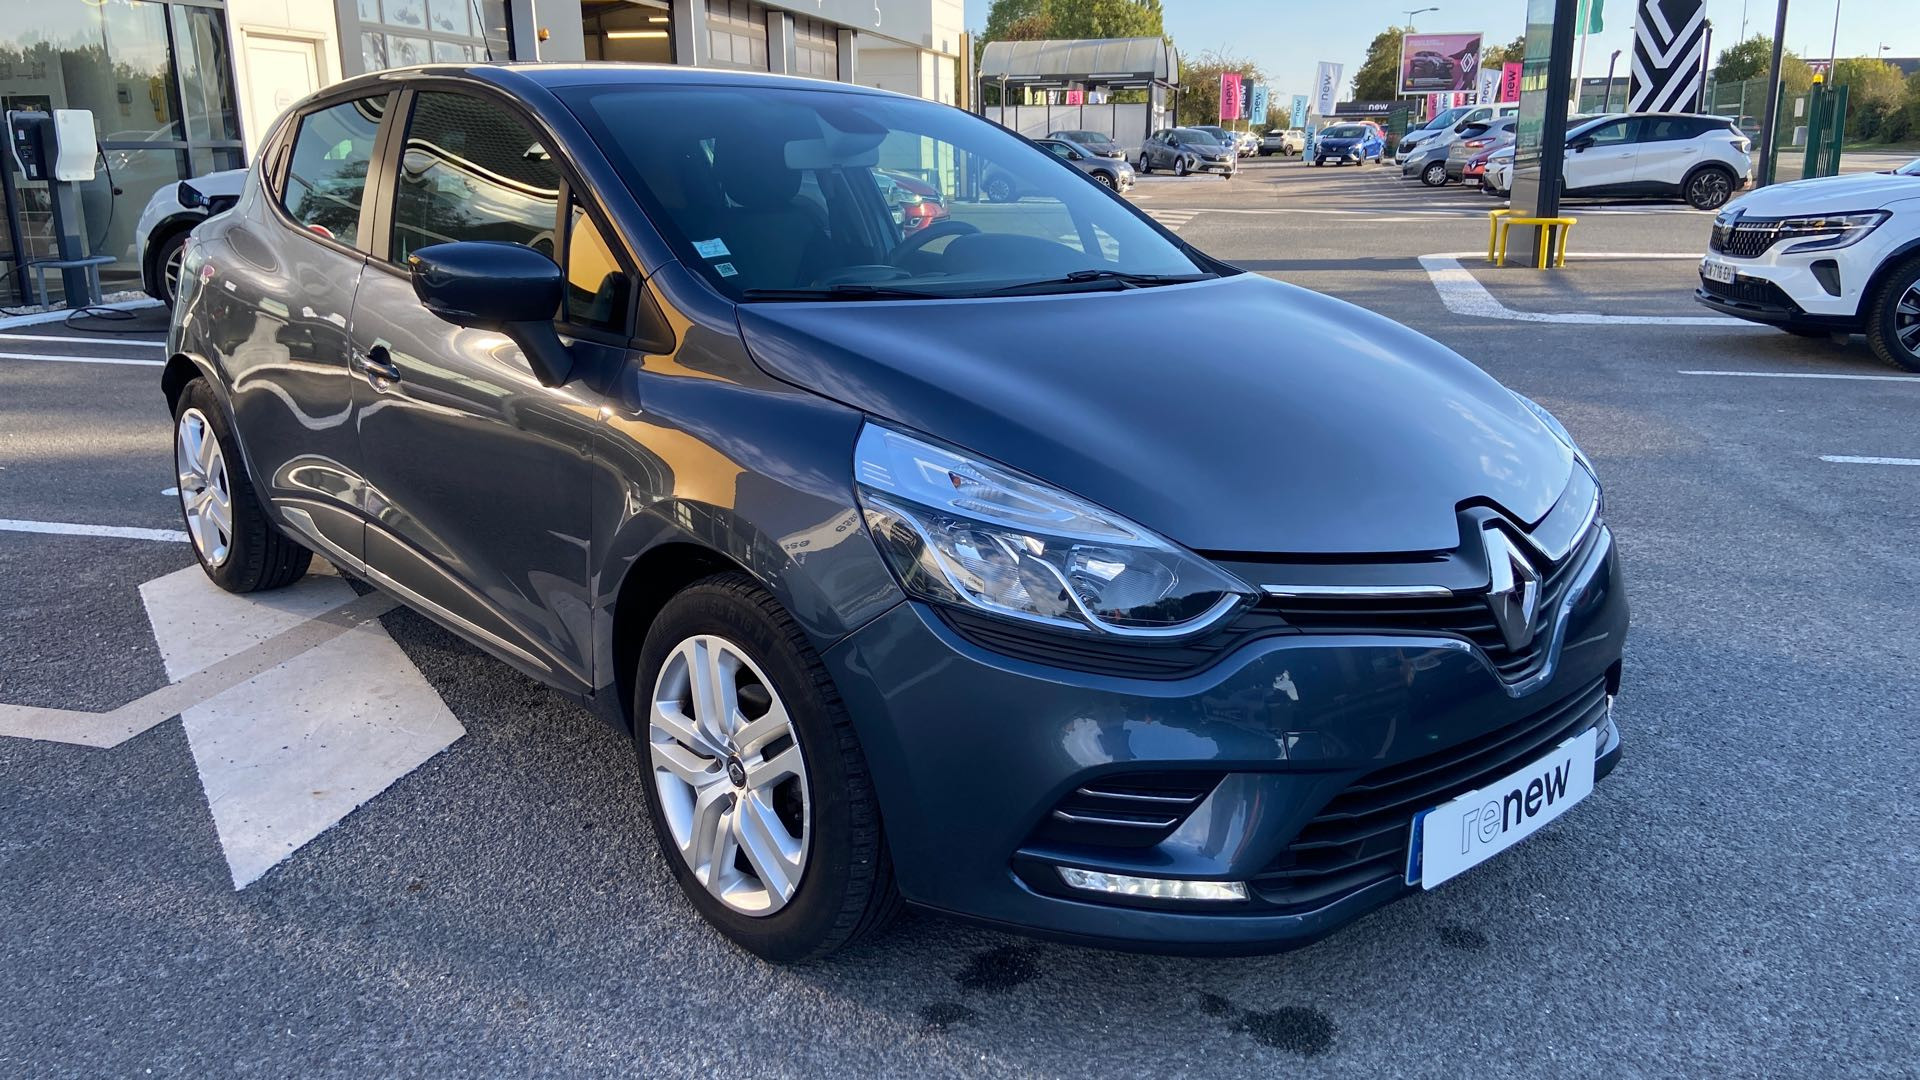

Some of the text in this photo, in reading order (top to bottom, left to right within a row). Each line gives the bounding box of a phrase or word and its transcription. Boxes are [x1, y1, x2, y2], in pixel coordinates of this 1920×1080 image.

[1226, 80, 1234, 105] new
[1322, 75, 1332, 101] new
[1507, 70, 1517, 98] new
[1254, 92, 1262, 113] new
[1368, 103, 1389, 111] new
[1462, 758, 1571, 855] renew
